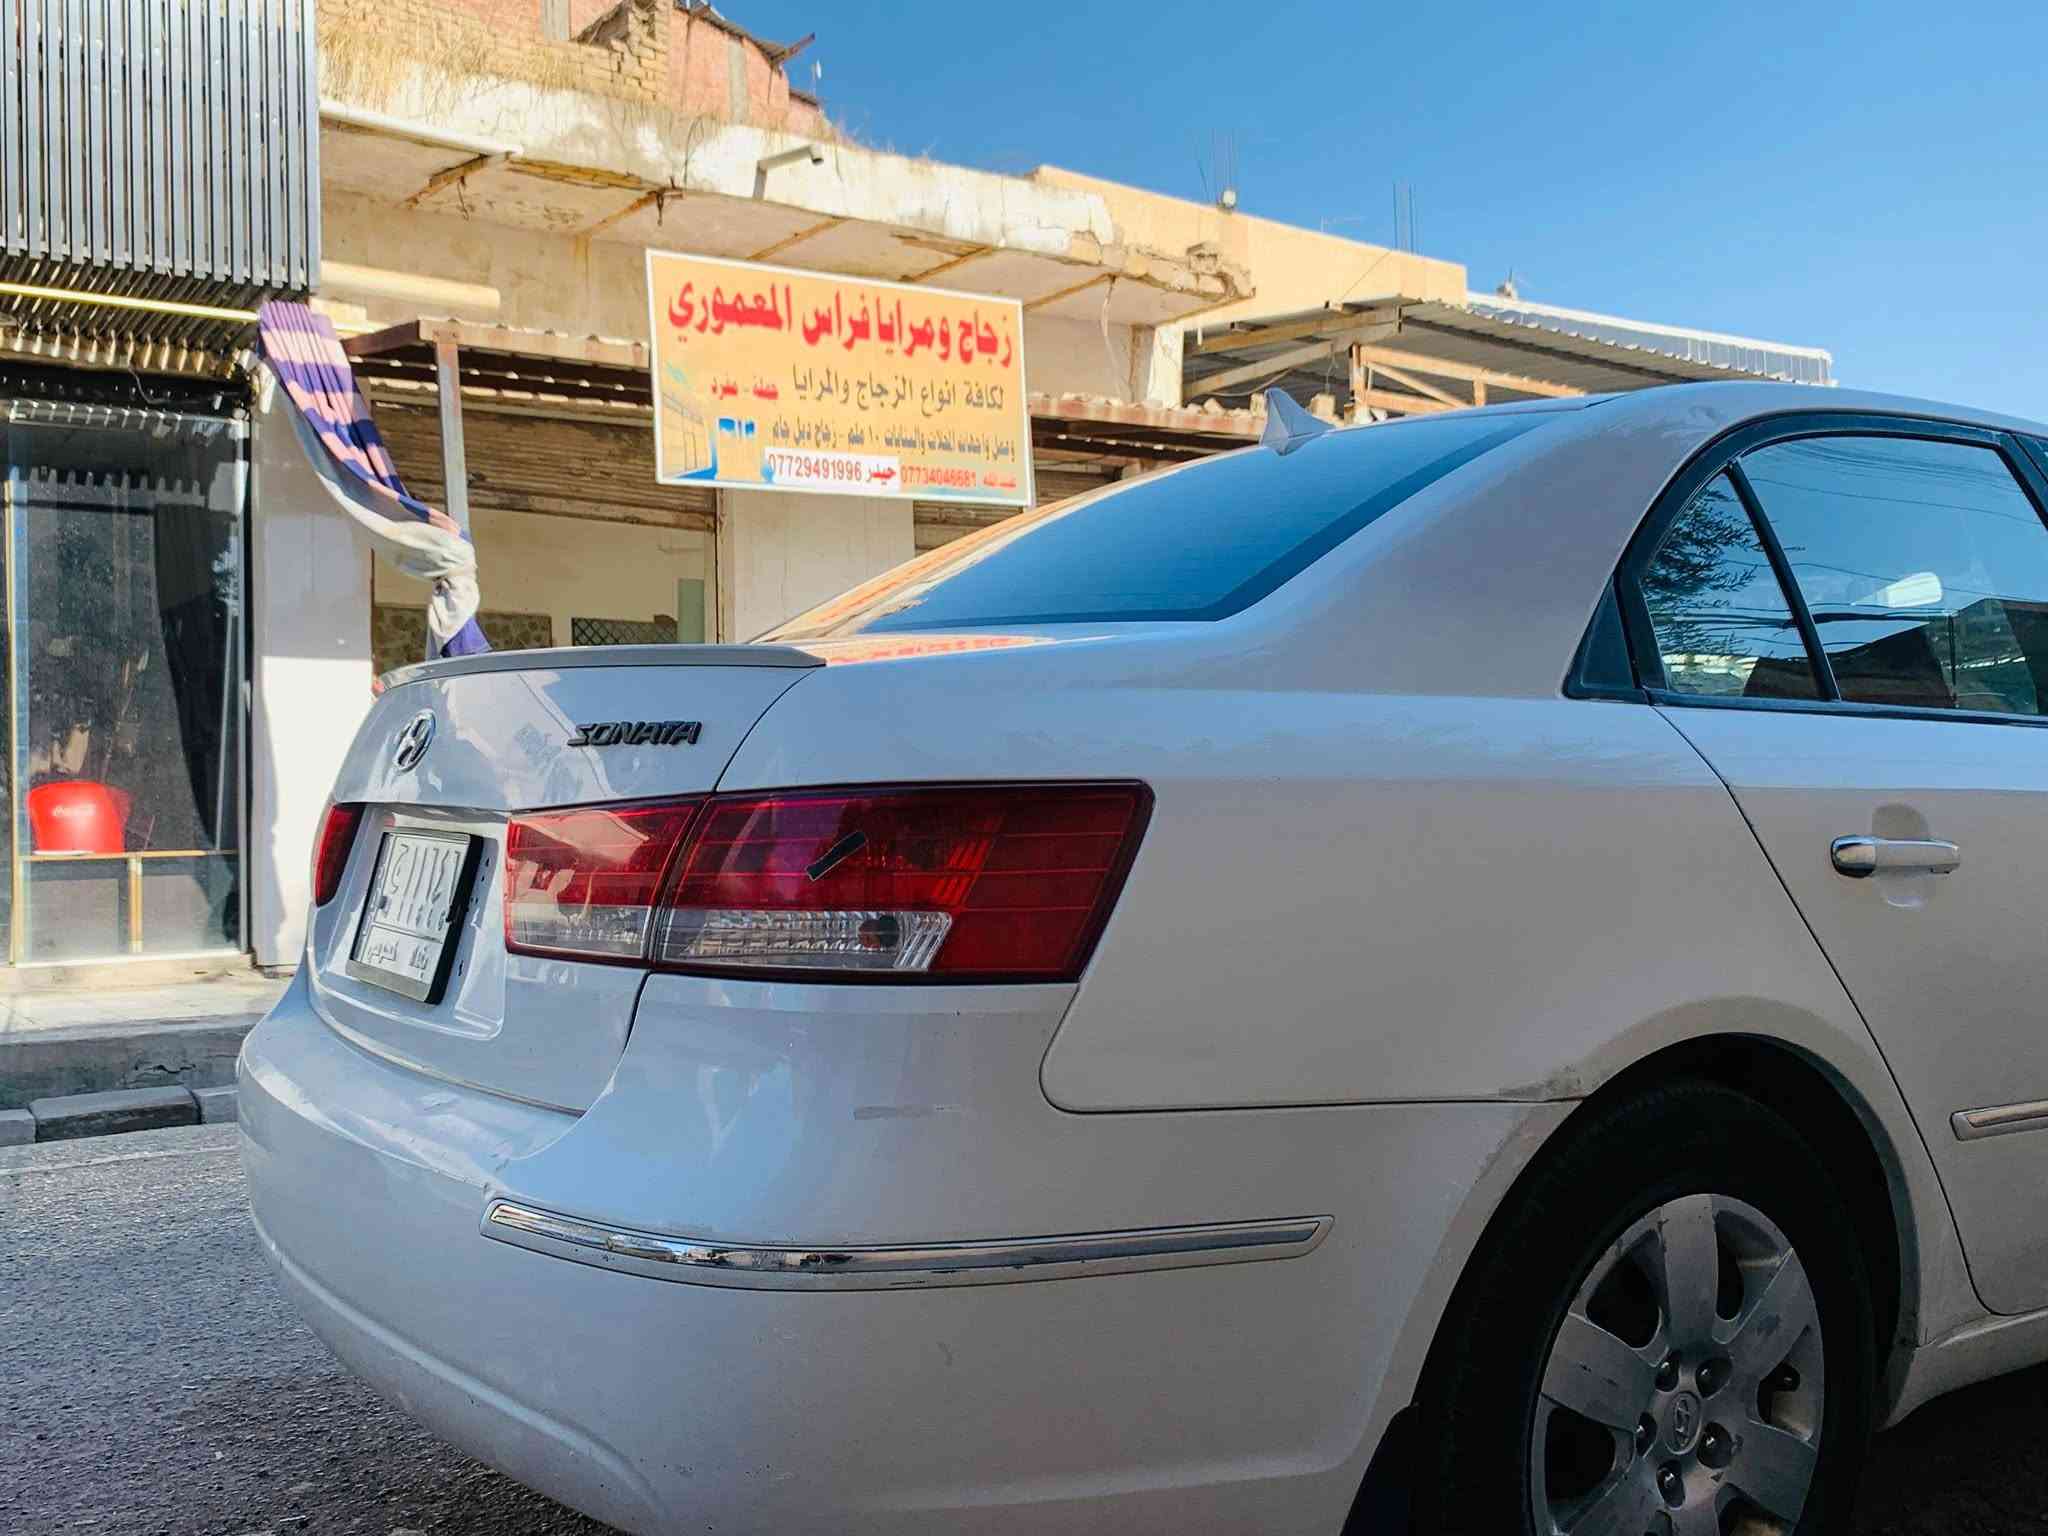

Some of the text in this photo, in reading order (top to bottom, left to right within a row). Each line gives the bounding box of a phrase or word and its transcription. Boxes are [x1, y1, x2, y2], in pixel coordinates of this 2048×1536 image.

[668, 281, 1012, 368] زجاج ومرايا فراس المعموري
[792, 362, 1005, 418] لكافة انواع الزجاج والمرايا
[767, 453, 862, 481] 07729491996
[866, 463, 897, 486] حيدر
[567, 720, 703, 747] SONATA
